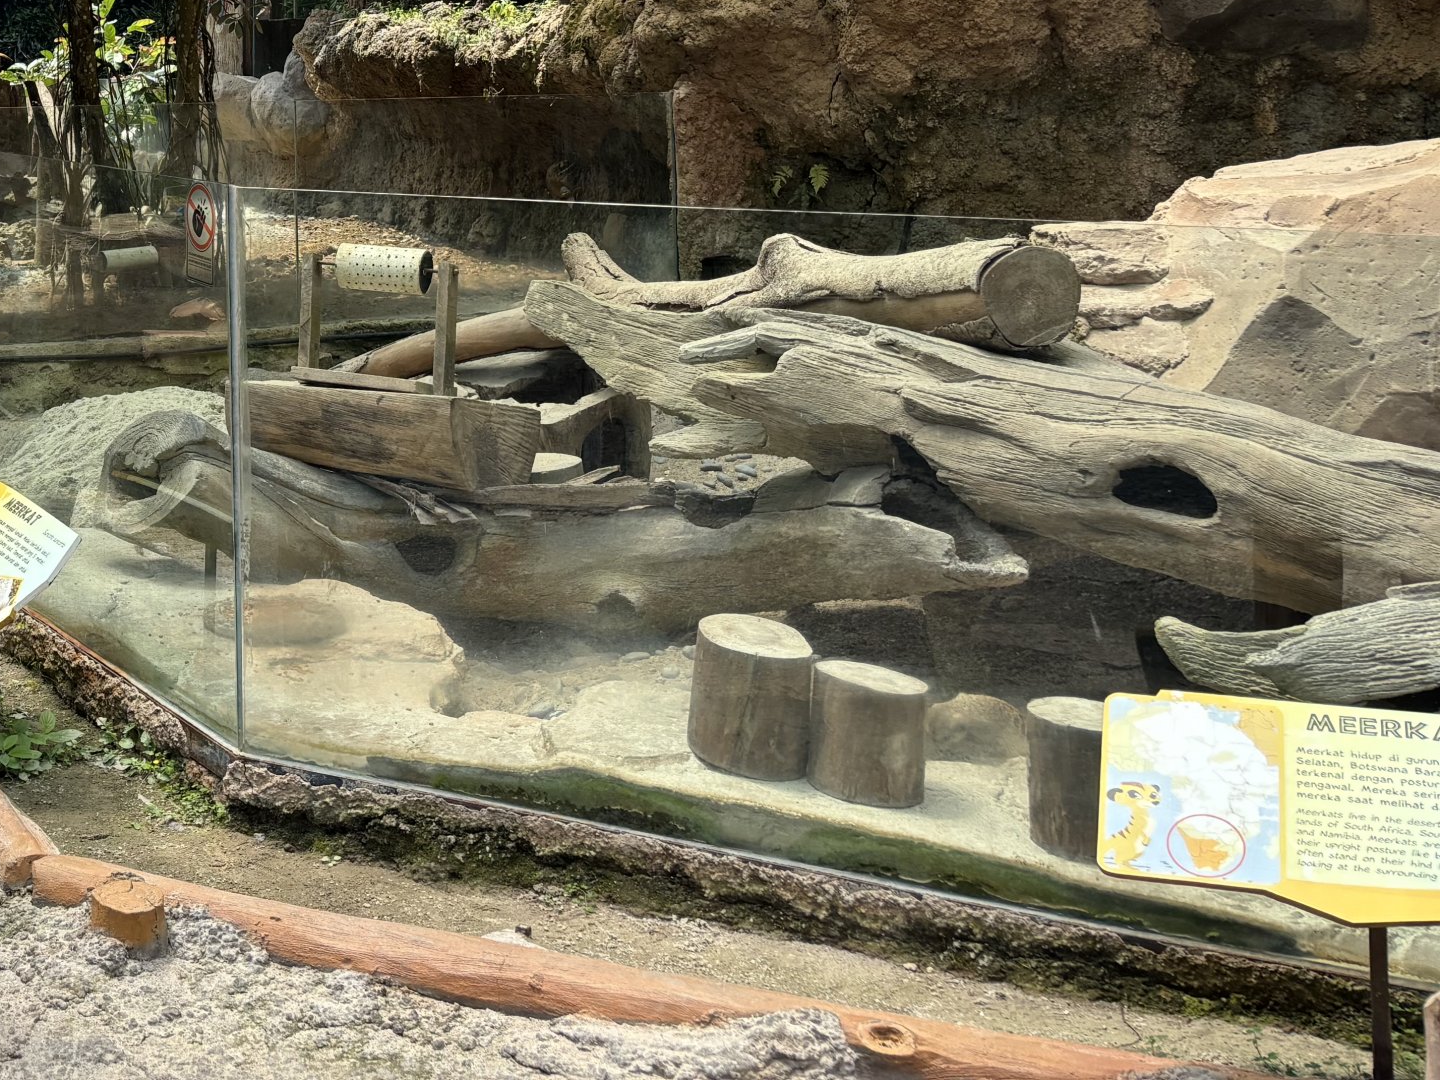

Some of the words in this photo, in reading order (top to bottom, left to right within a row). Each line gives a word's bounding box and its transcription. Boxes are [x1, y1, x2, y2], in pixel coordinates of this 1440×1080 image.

[3, 498, 42, 526] MEERKAT
[1306, 713, 1440, 741] MEERK
[1296, 746, 1344, 758] Meerkat
[1350, 750, 1382, 761] hidup
[1389, 754, 1400, 762] di
[1406, 756, 1440, 766] gurun
[1296, 757, 1343, 769] Selatan,
[1350, 761, 1408, 774] Botswana
[1296, 768, 1345, 779] terkenal
[1351, 773, 1394, 784] dengan
[1296, 780, 1354, 791] pengawal.
[1361, 785, 1407, 796] Mereka
[1296, 791, 1341, 802] mereka
[1347, 796, 1374, 805] saat
[1380, 799, 1425, 810] melihat
[1296, 807, 1343, 819] Meerkats
[1348, 811, 1366, 821] live
[1371, 813, 1380, 822] in
[1385, 816, 1402, 825] the
[1296, 817, 1322, 827] lands
[1327, 820, 1339, 828] of
[1344, 822, 1374, 832] South
[1296, 828, 1315, 837] and
[1368, 835, 1418, 847] Meerkats
[1296, 838, 1321, 847] their
[1325, 841, 1361, 852] upright
[1366, 845, 1407, 856] posture
[1412, 849, 1429, 858] like
[1296, 848, 1324, 858] often
[1329, 852, 1357, 862] stand
[1381, 857, 1405, 866] their
[1410, 859, 1432, 869] hind
[1296, 859, 1332, 871] looking
[1337, 863, 1348, 871] at
[1353, 865, 1370, 874] the
[1376, 867, 1438, 882] surrounding
